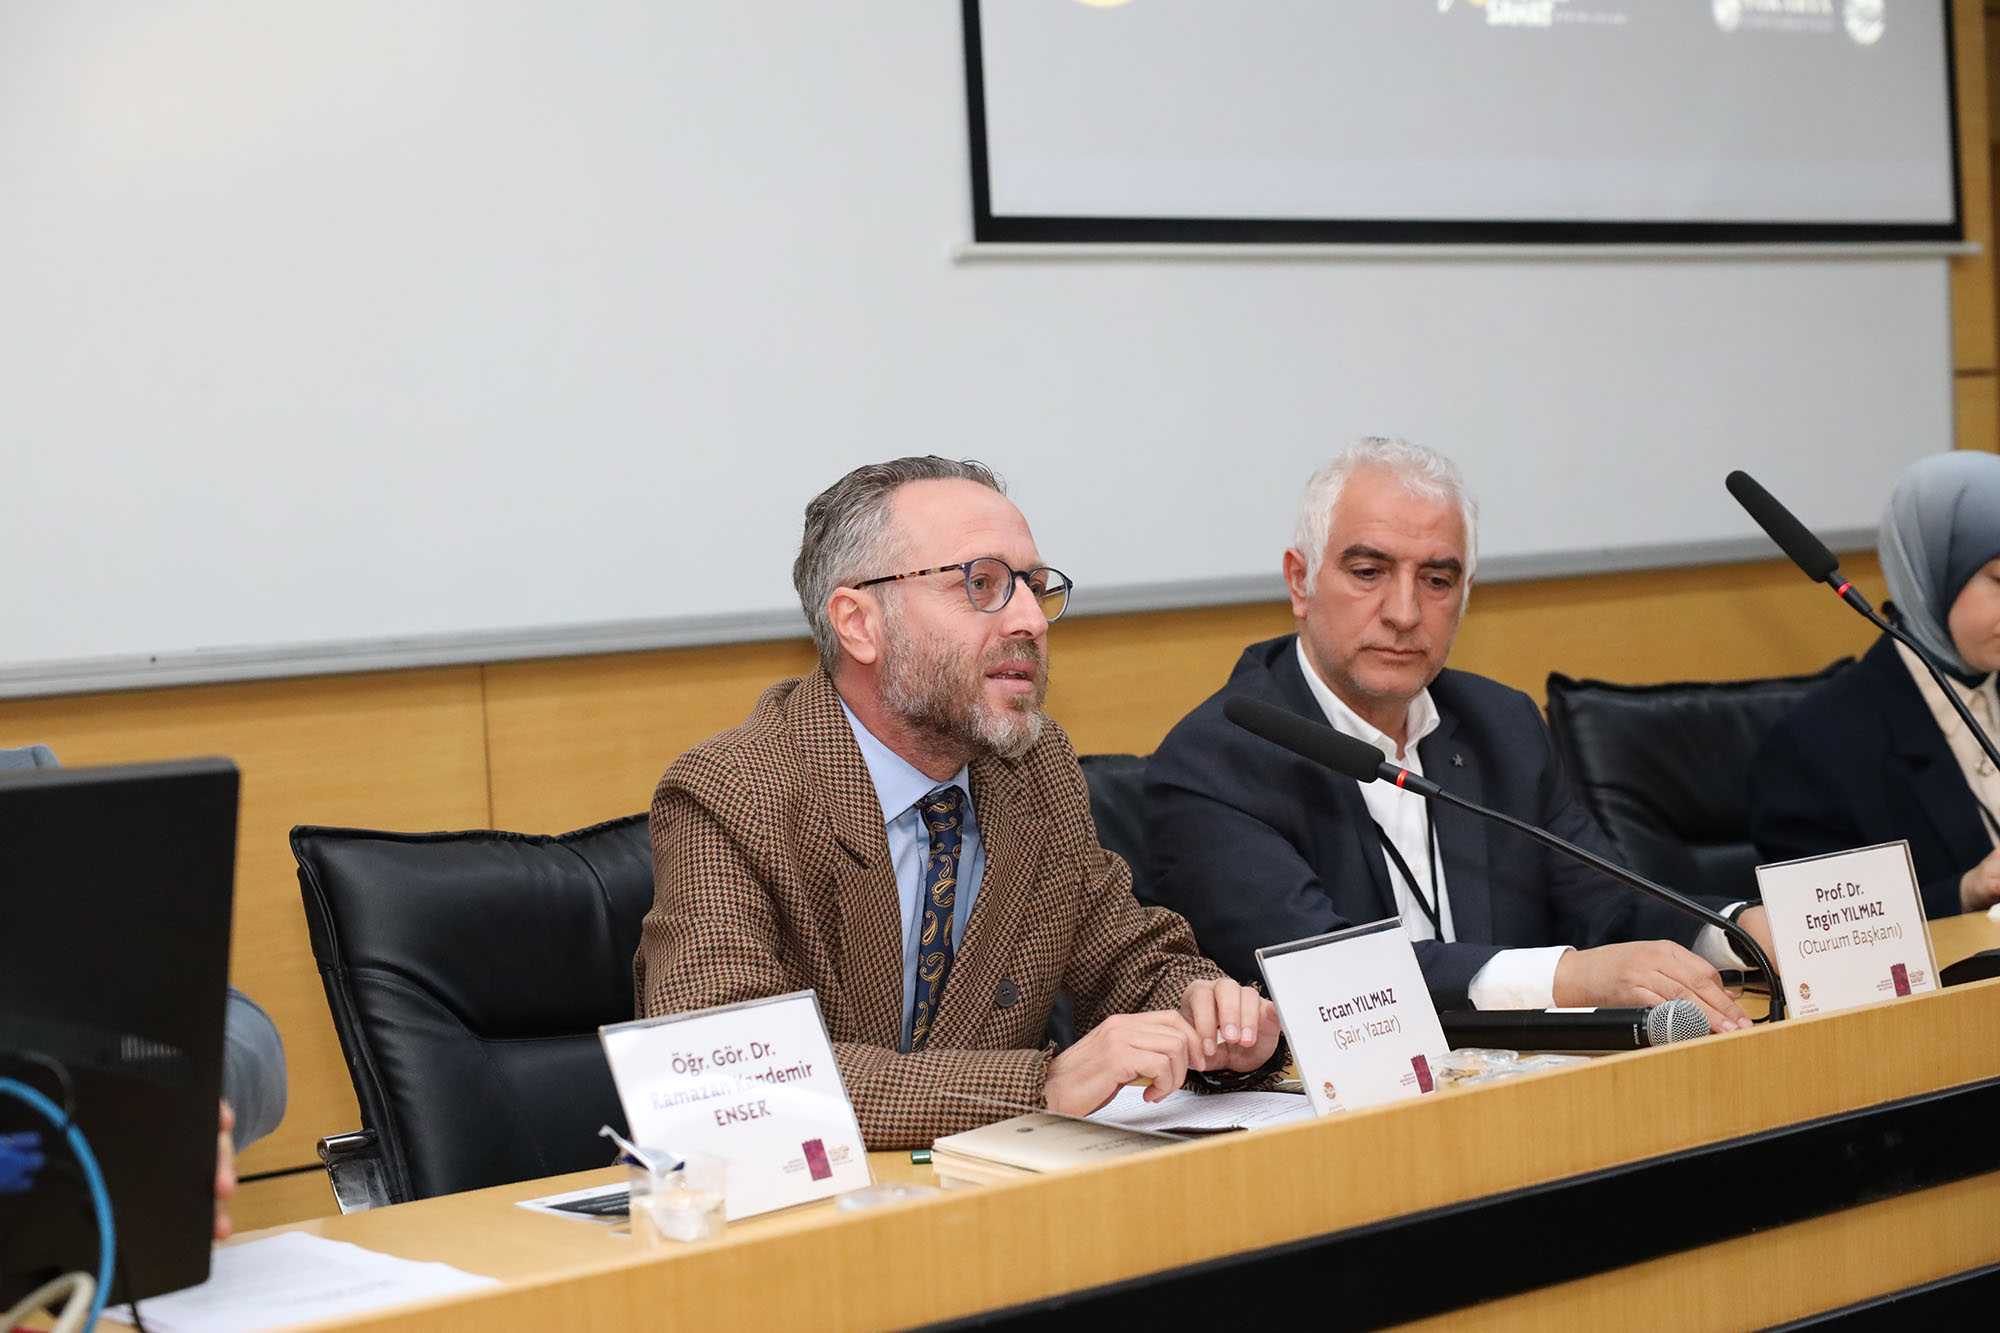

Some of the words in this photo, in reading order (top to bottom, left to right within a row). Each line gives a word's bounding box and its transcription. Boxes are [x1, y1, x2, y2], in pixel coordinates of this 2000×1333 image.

[1816, 883, 1846, 903] Prof.
[1846, 882, 1864, 897] Dr.
[1805, 910, 1841, 931] Engin
[1840, 901, 1885, 923] YILMAZ
[1798, 934, 1851, 959] (Oturum
[1851, 922, 1903, 946] Başkanı)
[1319, 1002, 1354, 1022] Ercan
[1351, 988, 1397, 1013] YILMAZ
[1334, 1025, 1365, 1051] (Şair,
[1363, 1015, 1401, 1038] Yazar)
[672, 1052, 710, 1077] Öğr.
[712, 1045, 749, 1066] Gör.
[750, 1041, 776, 1060] Dr.
[714, 1100, 771, 1127] ENSER
